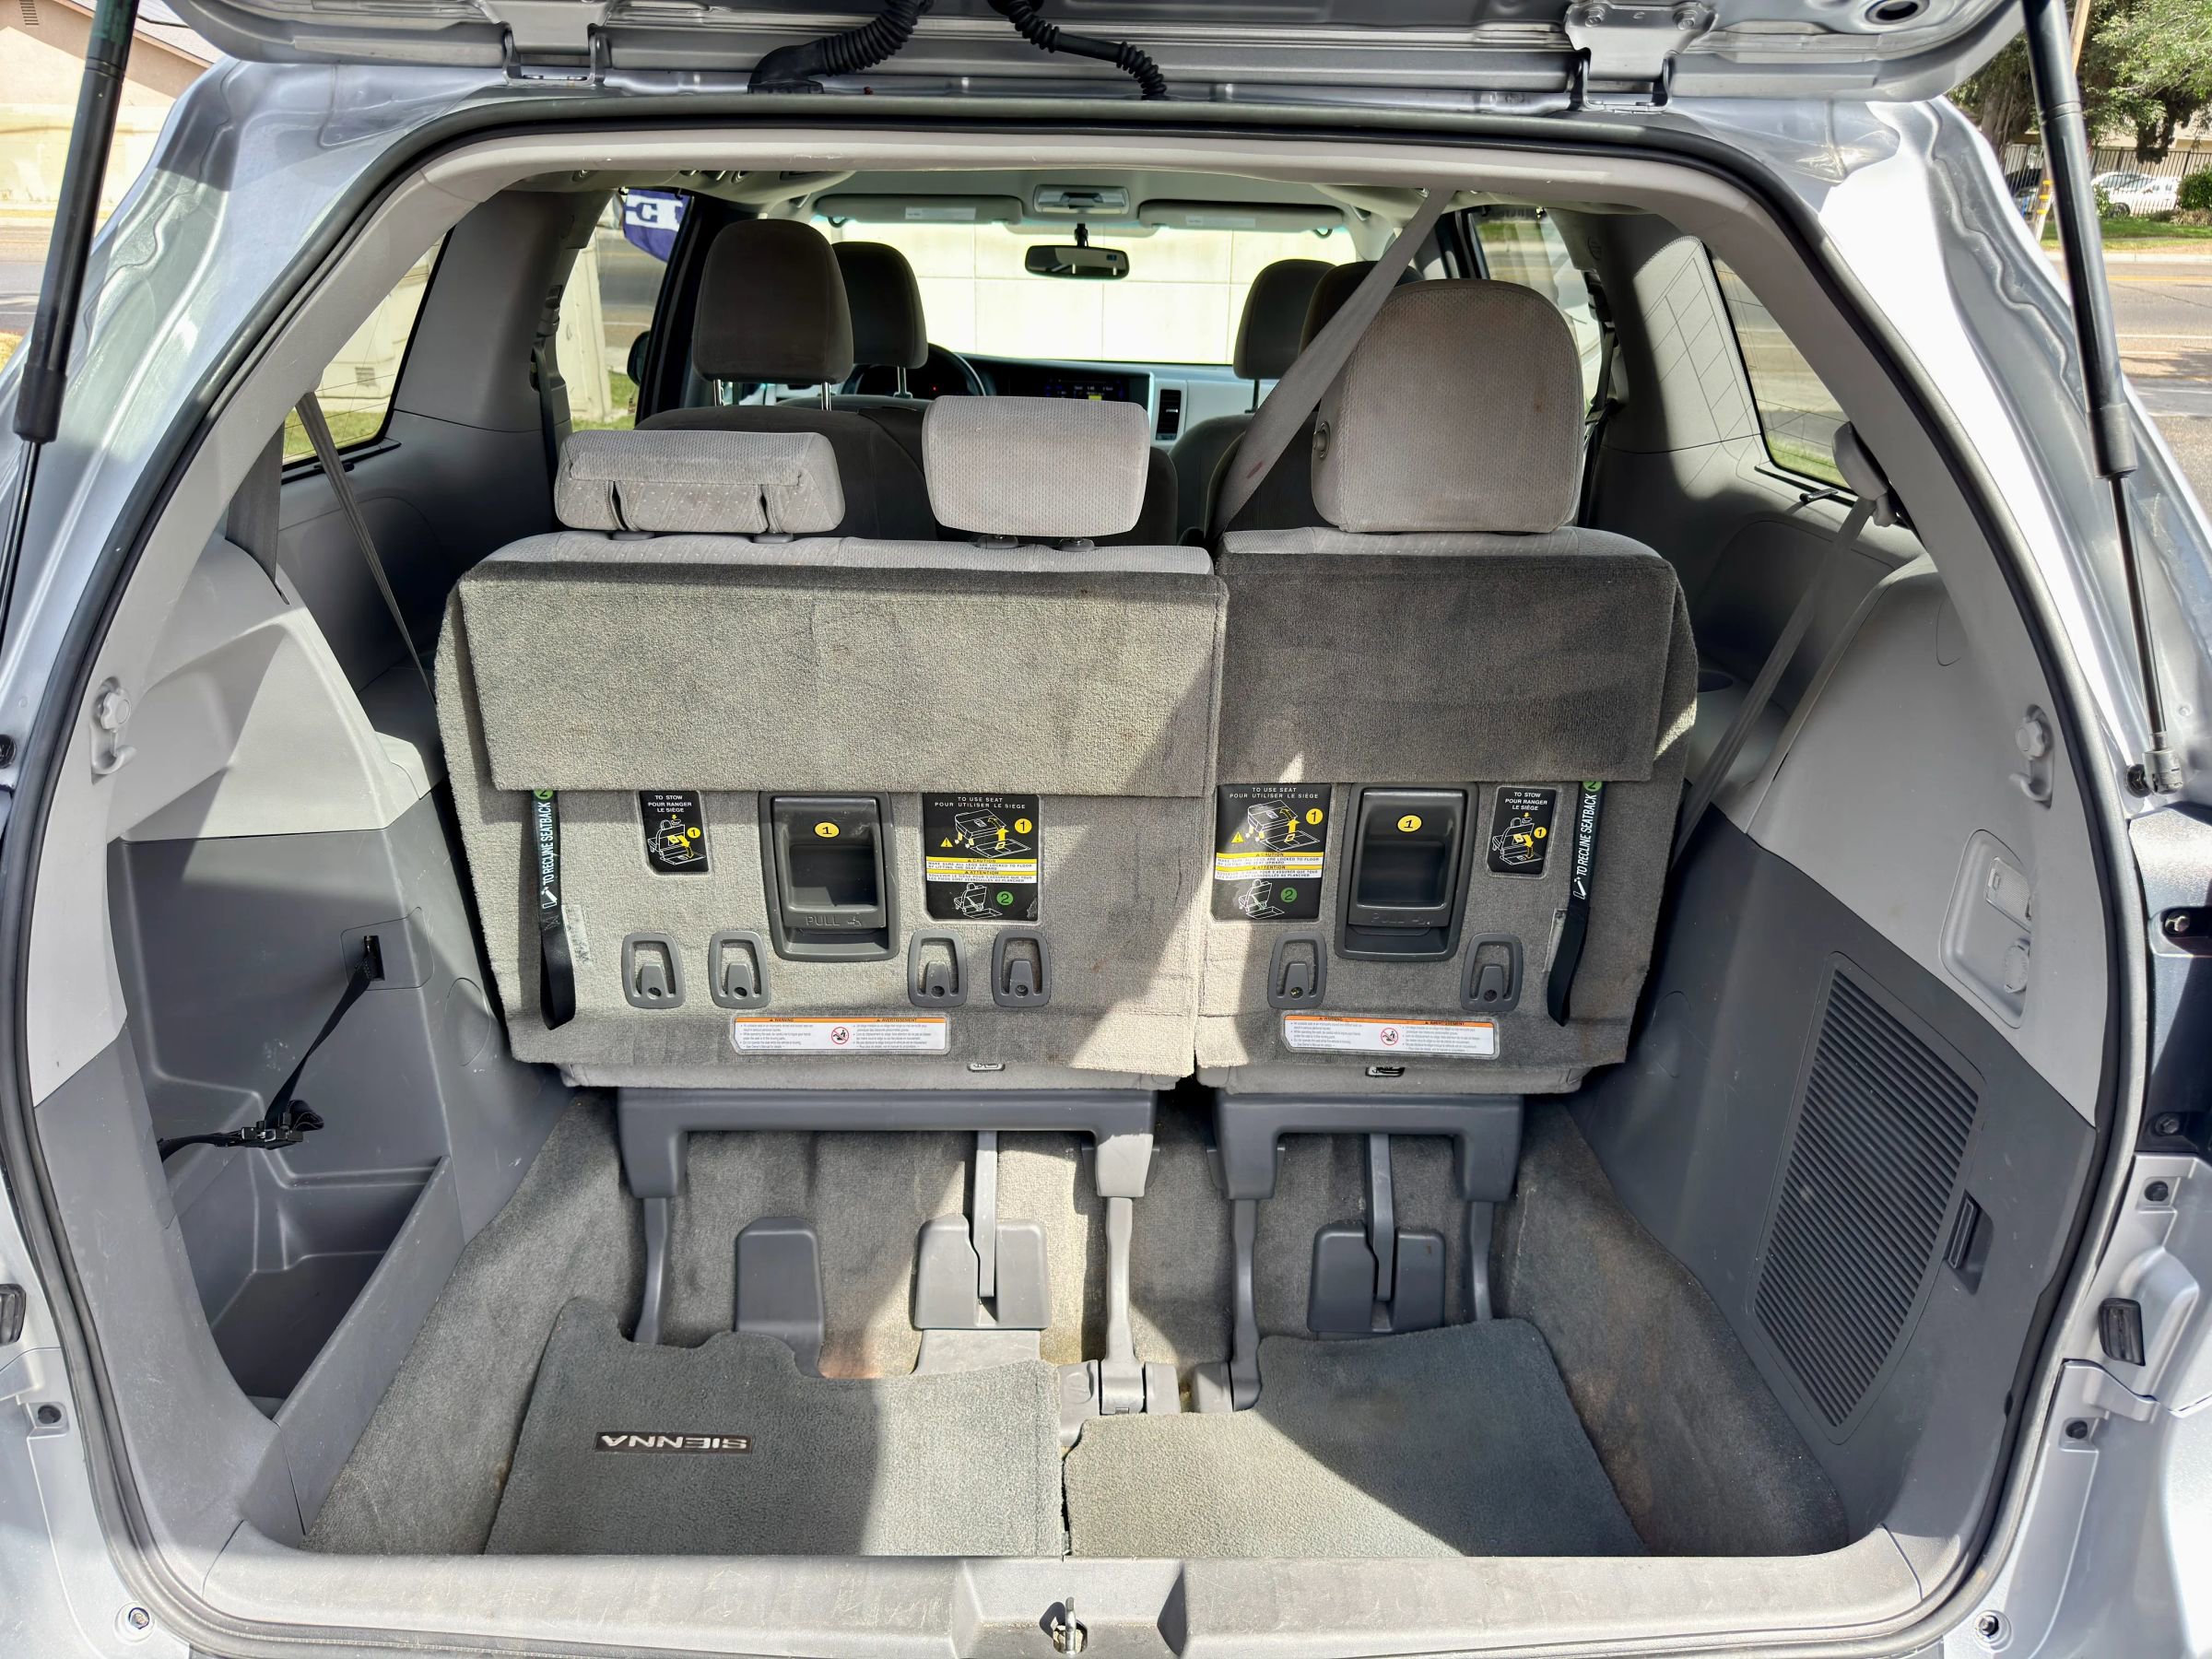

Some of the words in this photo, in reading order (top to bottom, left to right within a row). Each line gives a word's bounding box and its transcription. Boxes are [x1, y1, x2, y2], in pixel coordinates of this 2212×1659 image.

[1580, 794, 1597, 834] SEATBACK
[538, 802, 553, 841] SEATBACK
[1404, 820, 1413, 828] 1
[822, 826, 832, 834] 1
[1578, 834, 1591, 865] RECLINE
[541, 843, 554, 877] RECLINE
[1577, 865, 1587, 876] TO
[543, 876, 554, 886] TO
[1001, 893, 1009, 904] 2
[1285, 889, 1293, 900] 2
[805, 914, 841, 926] PULL
[602, 1435, 747, 1449] SIENNA
